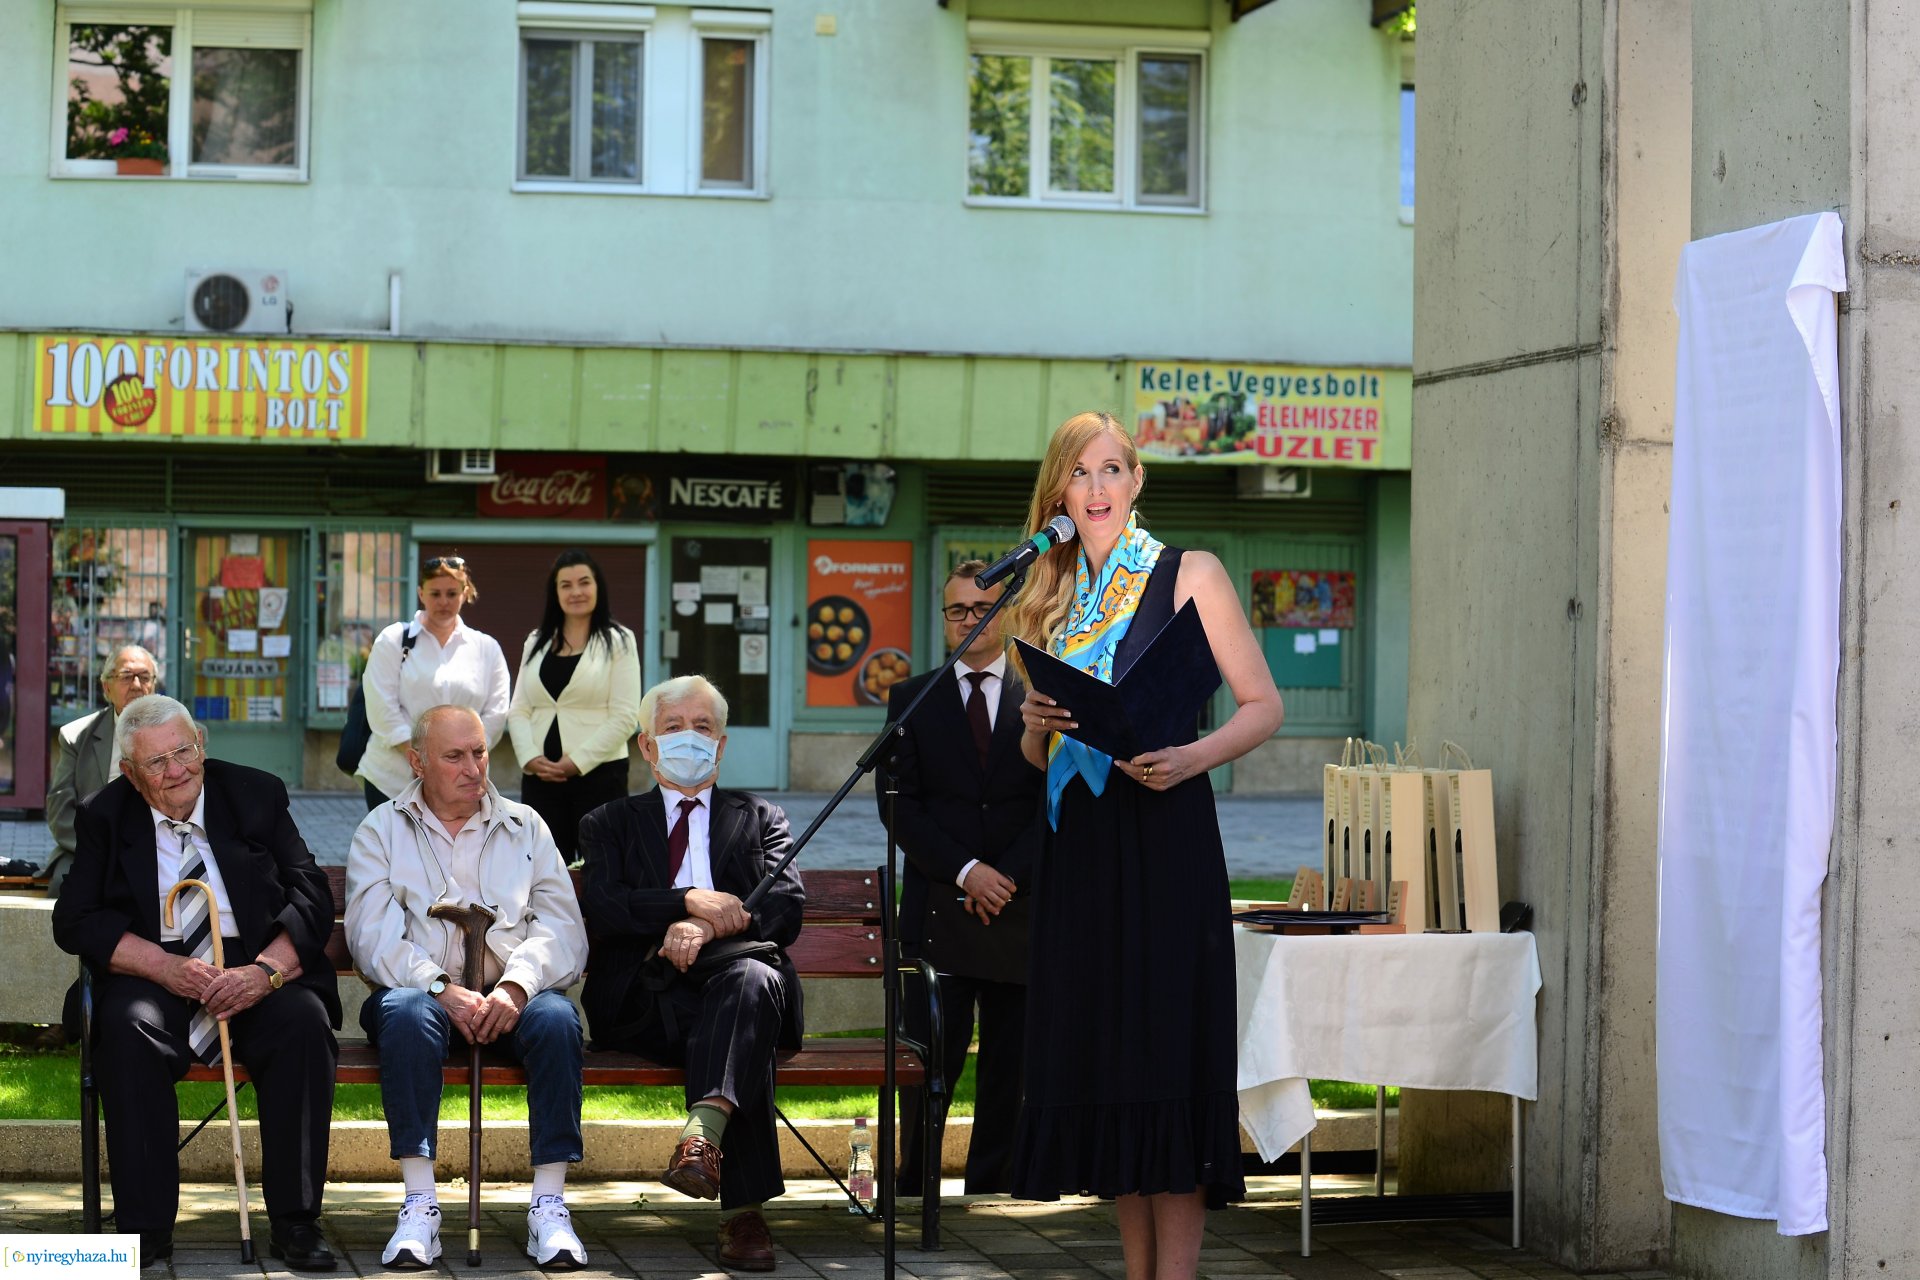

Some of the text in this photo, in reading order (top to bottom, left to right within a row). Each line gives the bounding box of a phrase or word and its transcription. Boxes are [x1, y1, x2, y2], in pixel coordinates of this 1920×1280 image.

[261, 296, 278, 305] LG
[46, 342, 350, 408] 100 FORINTOS
[111, 377, 144, 405] 100
[1140, 366, 1380, 398] Kelet-Vegyesbolt
[264, 397, 344, 431] BOLT
[669, 477, 783, 509] NESCAFÉ
